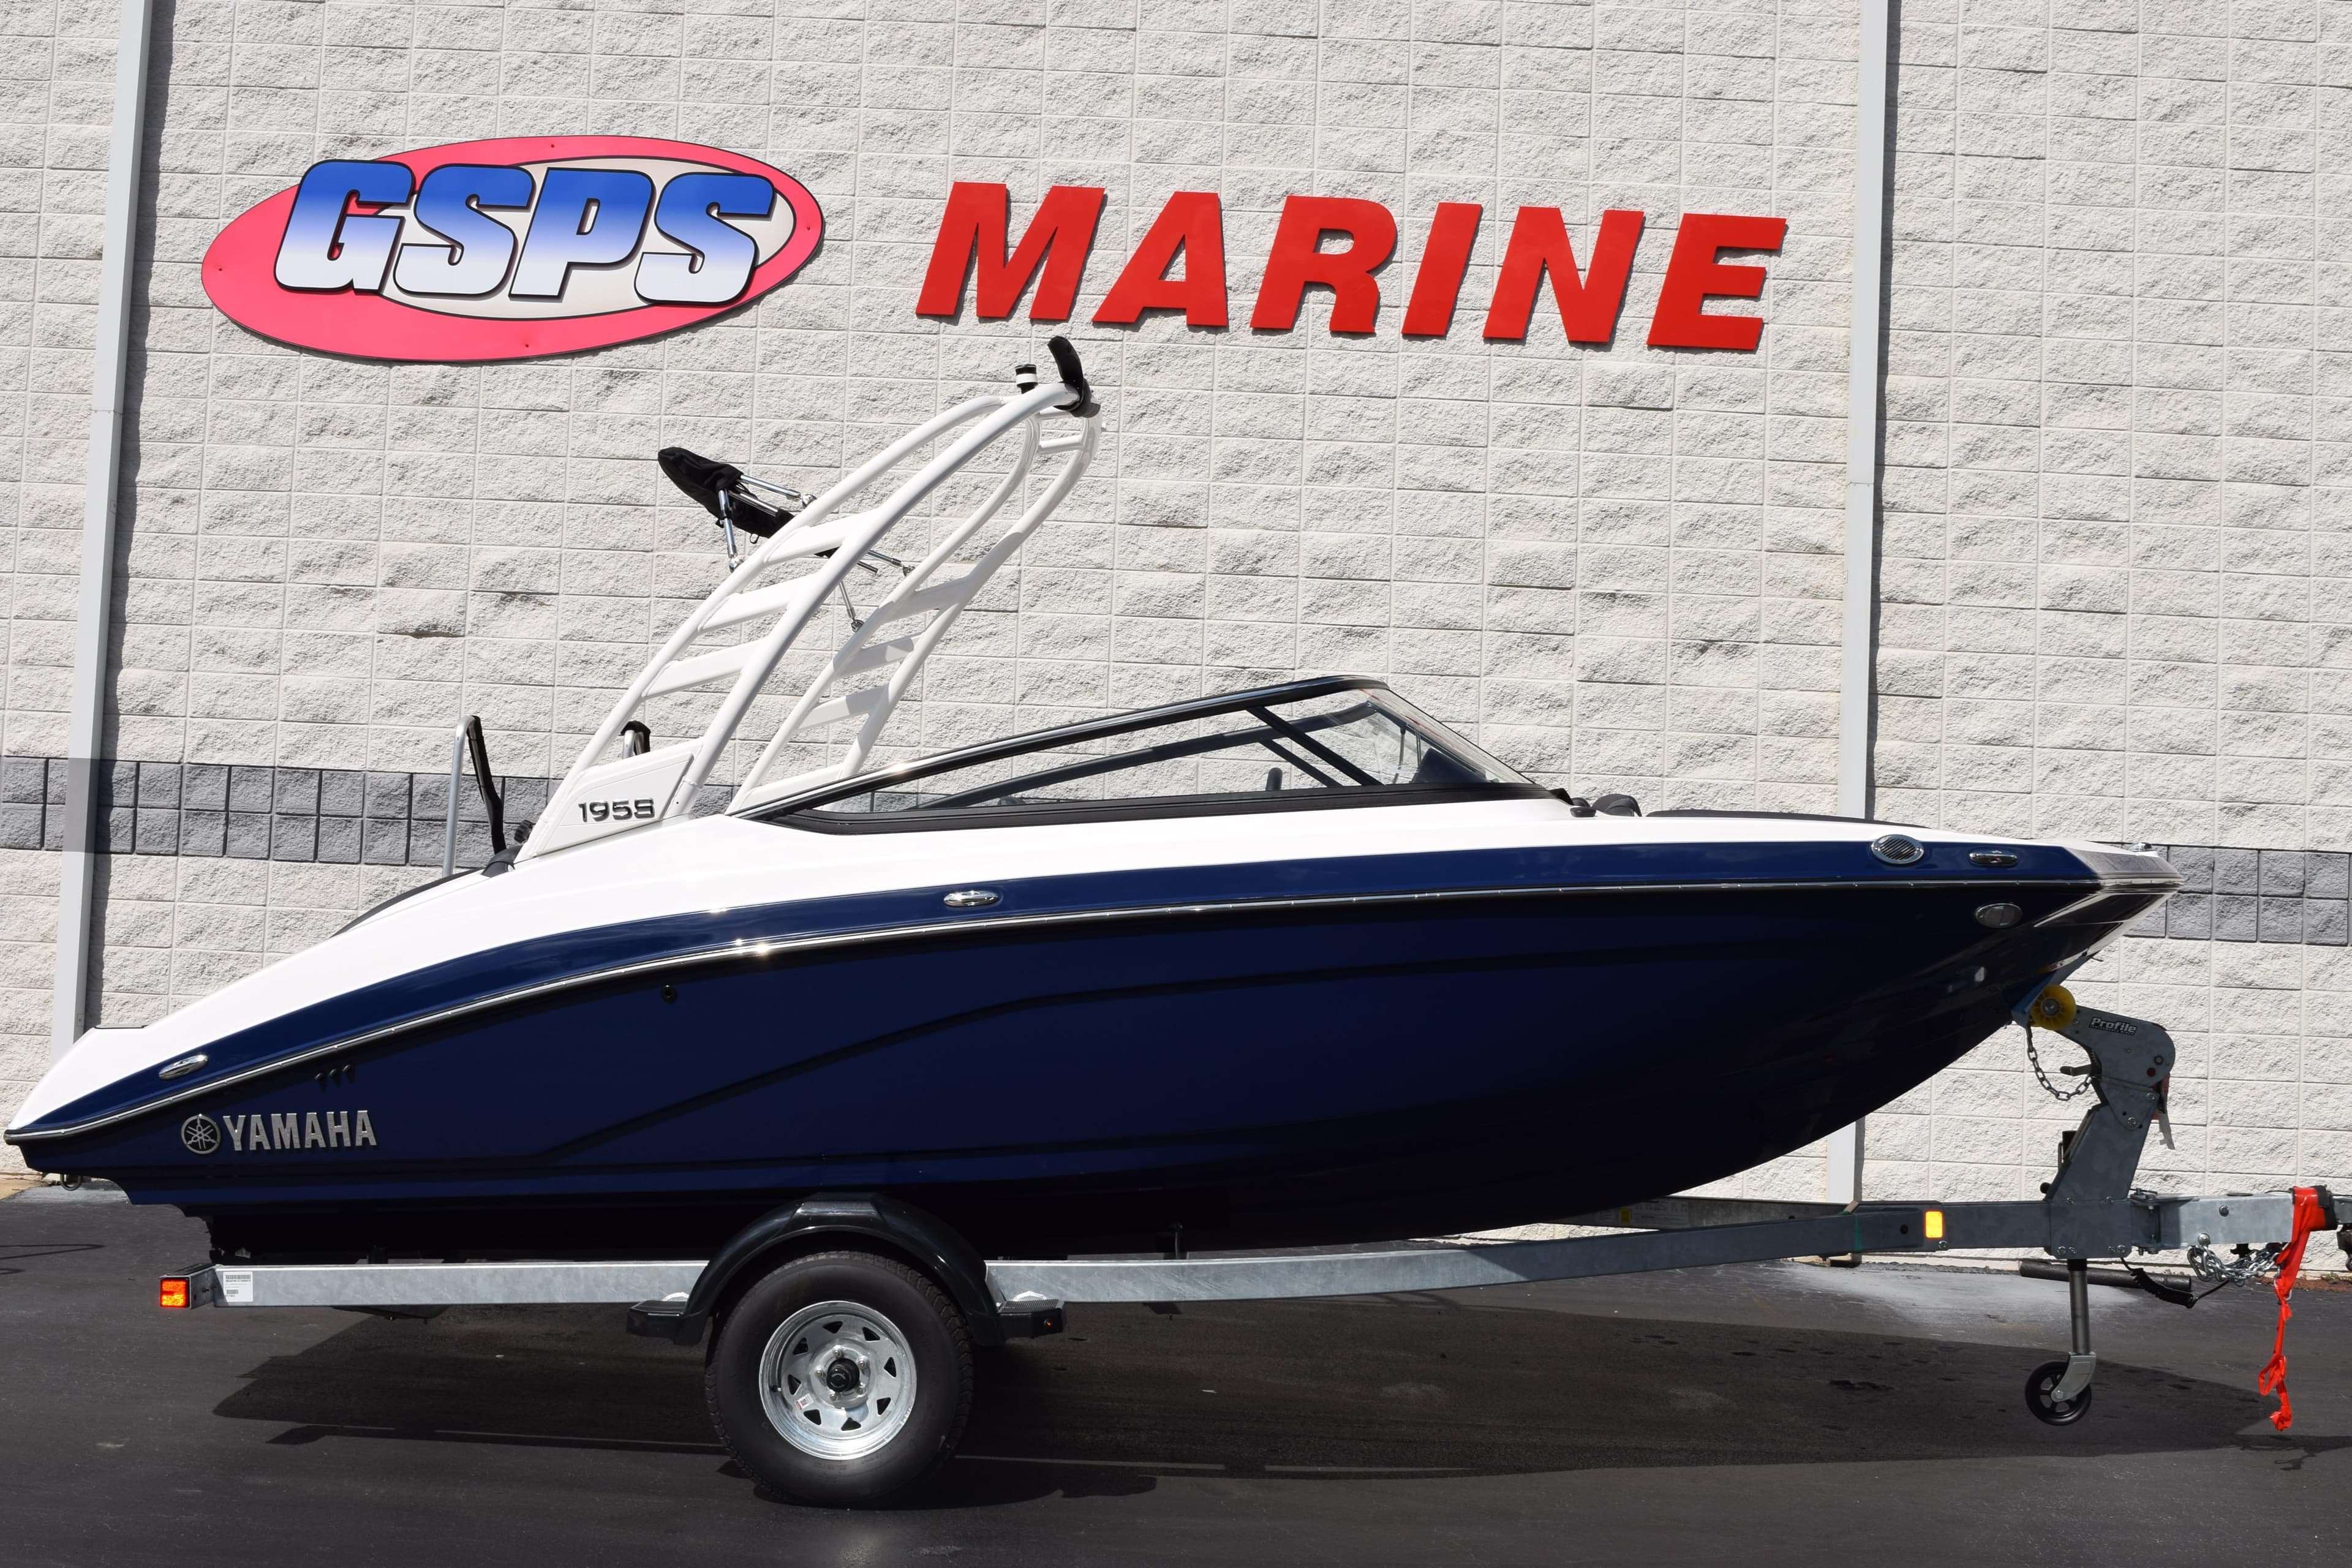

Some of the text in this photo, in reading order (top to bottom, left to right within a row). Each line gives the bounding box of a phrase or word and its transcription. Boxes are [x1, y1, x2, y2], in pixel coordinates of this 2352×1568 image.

[274, 159, 775, 304] GSPS
[916, 181, 1787, 350] MARINE
[2090, 1017, 2137, 1033] Profile
[222, 1110, 377, 1151] YAMAHA
